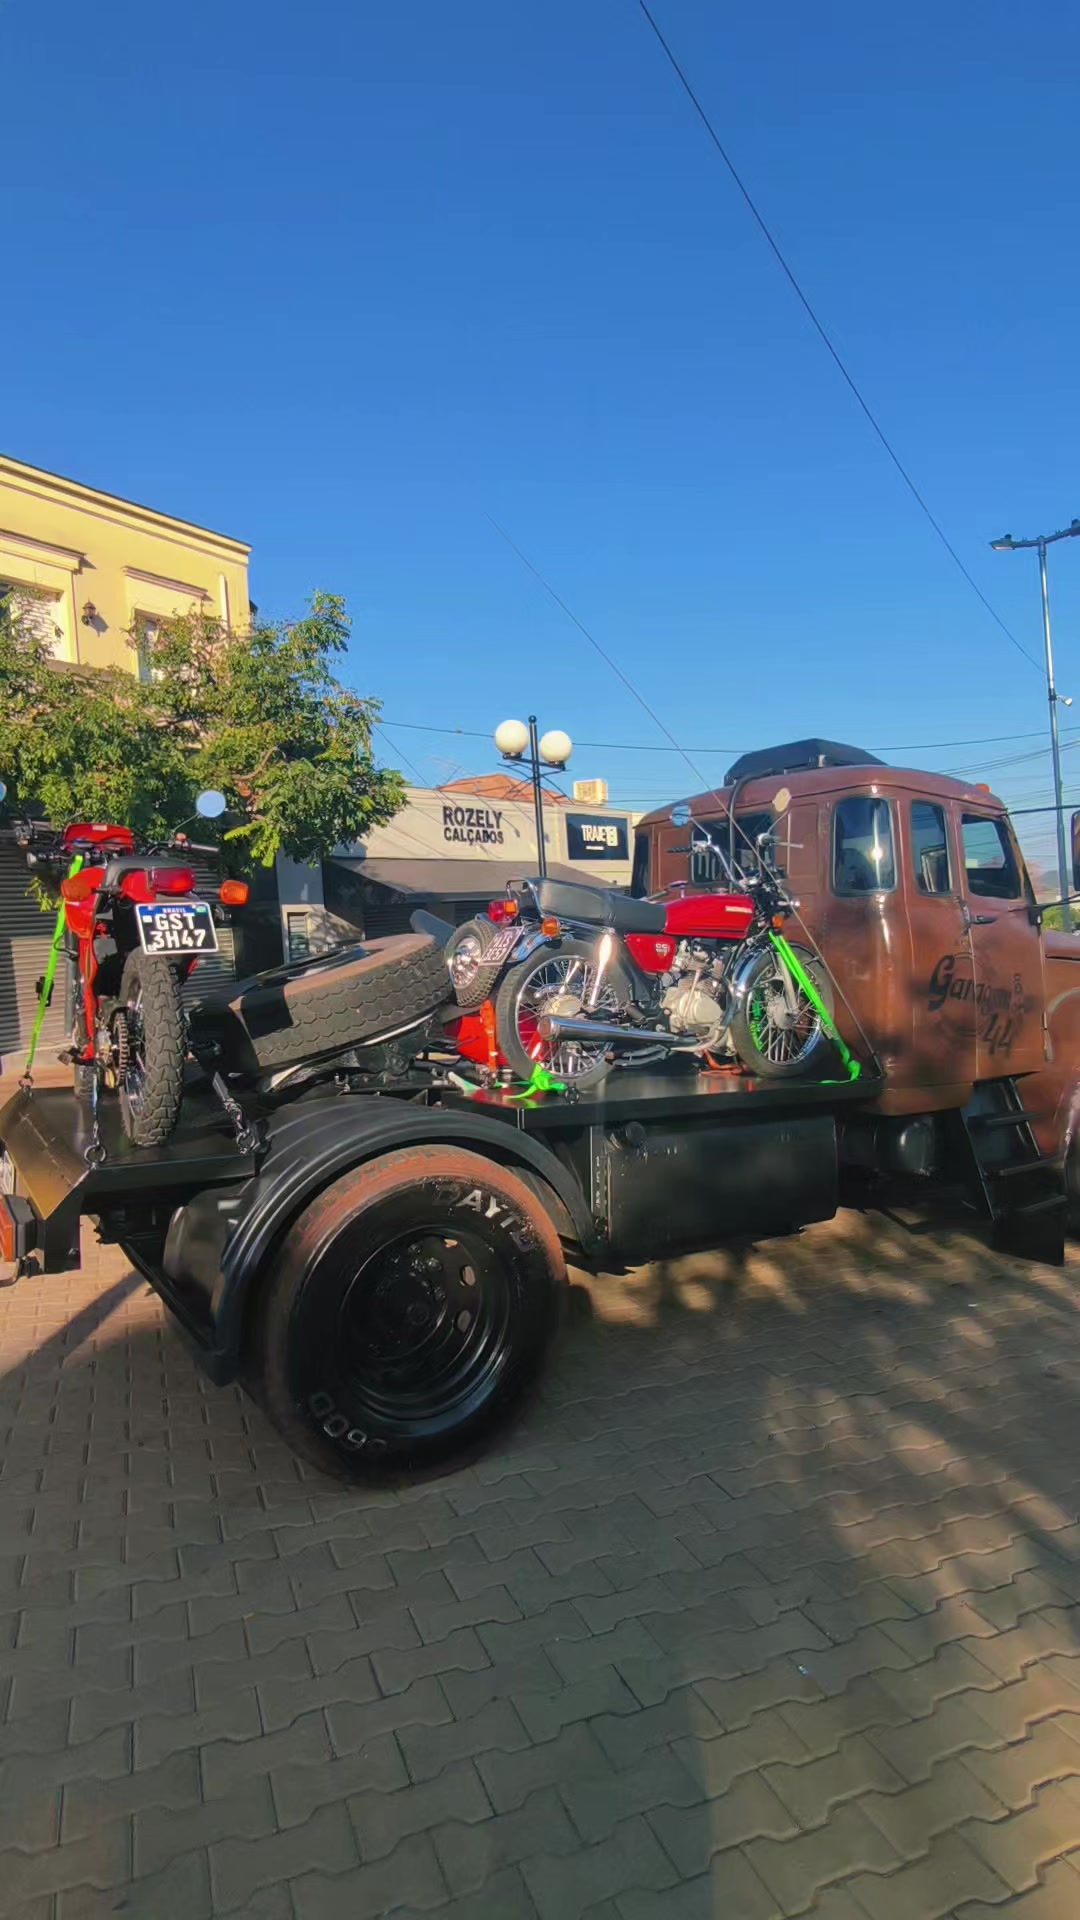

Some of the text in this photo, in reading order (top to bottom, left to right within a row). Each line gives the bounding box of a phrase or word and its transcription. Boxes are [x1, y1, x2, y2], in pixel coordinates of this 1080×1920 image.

[443, 805, 502, 829] ROZELY
[444, 827, 504, 846] CALÇADOS
[154, 912, 195, 931] GST
[150, 929, 206, 949] 3H47
